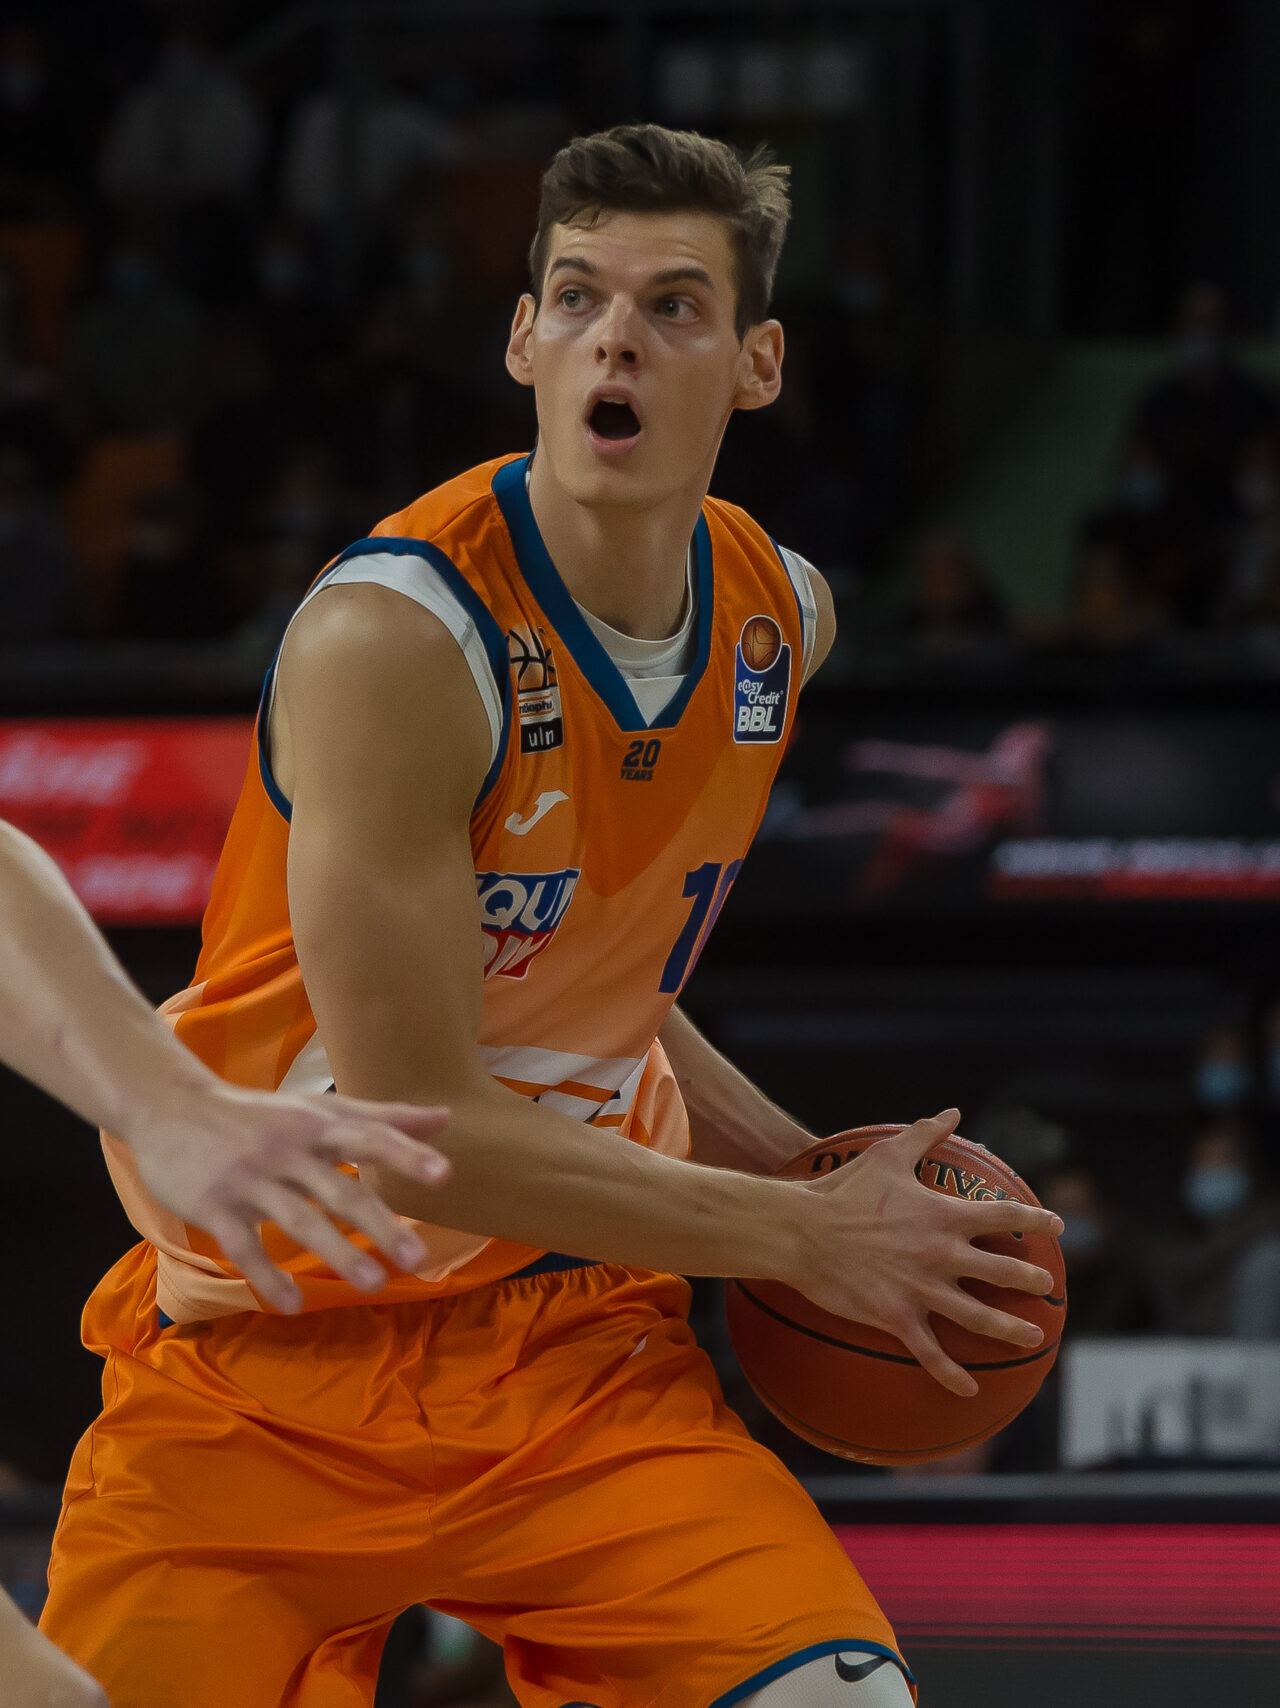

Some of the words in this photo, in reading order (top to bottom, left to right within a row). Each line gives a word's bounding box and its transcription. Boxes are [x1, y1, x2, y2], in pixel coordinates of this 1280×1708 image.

[736, 705, 777, 732] BBL
[622, 739, 662, 768] 20
[620, 768, 654, 781] YEARS
